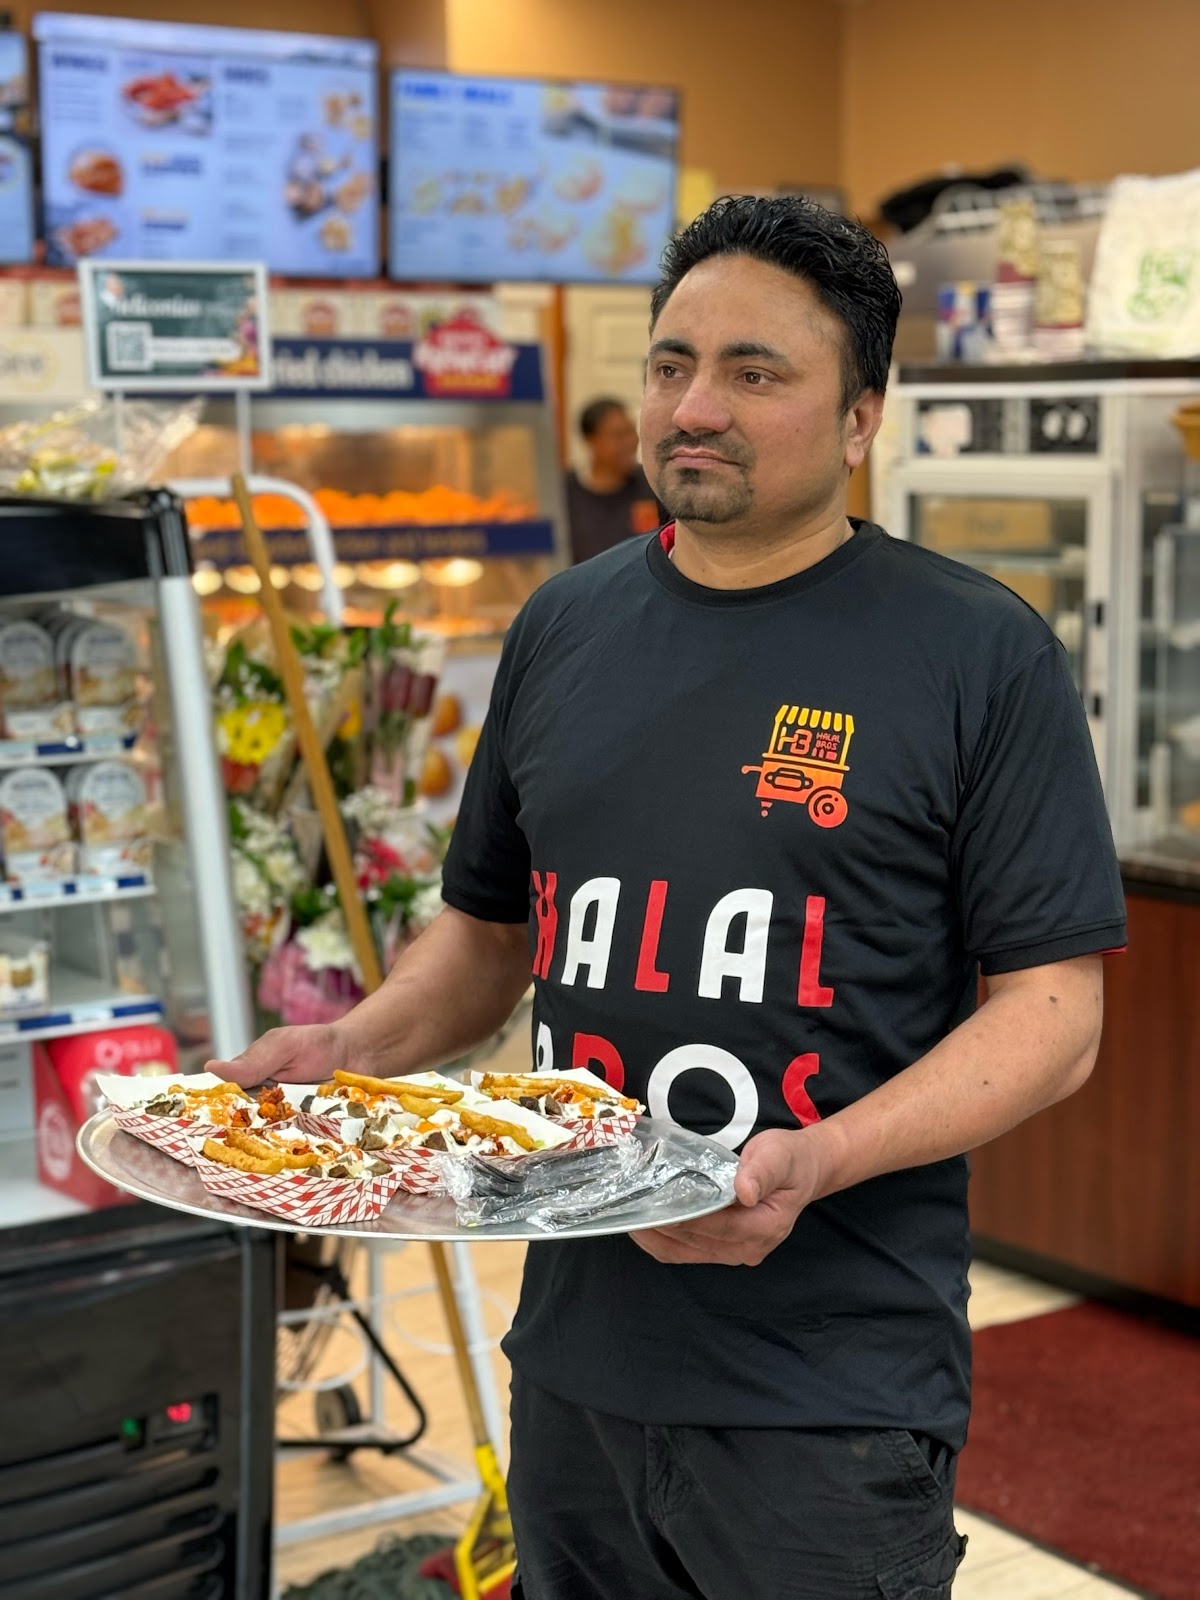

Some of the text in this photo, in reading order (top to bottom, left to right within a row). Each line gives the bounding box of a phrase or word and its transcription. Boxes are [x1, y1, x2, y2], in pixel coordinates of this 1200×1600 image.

[271, 347, 319, 389] ried
[815, 741, 838, 750] BROS
[816, 732, 840, 743] HALAL
[531, 870, 835, 1008] HALAL
